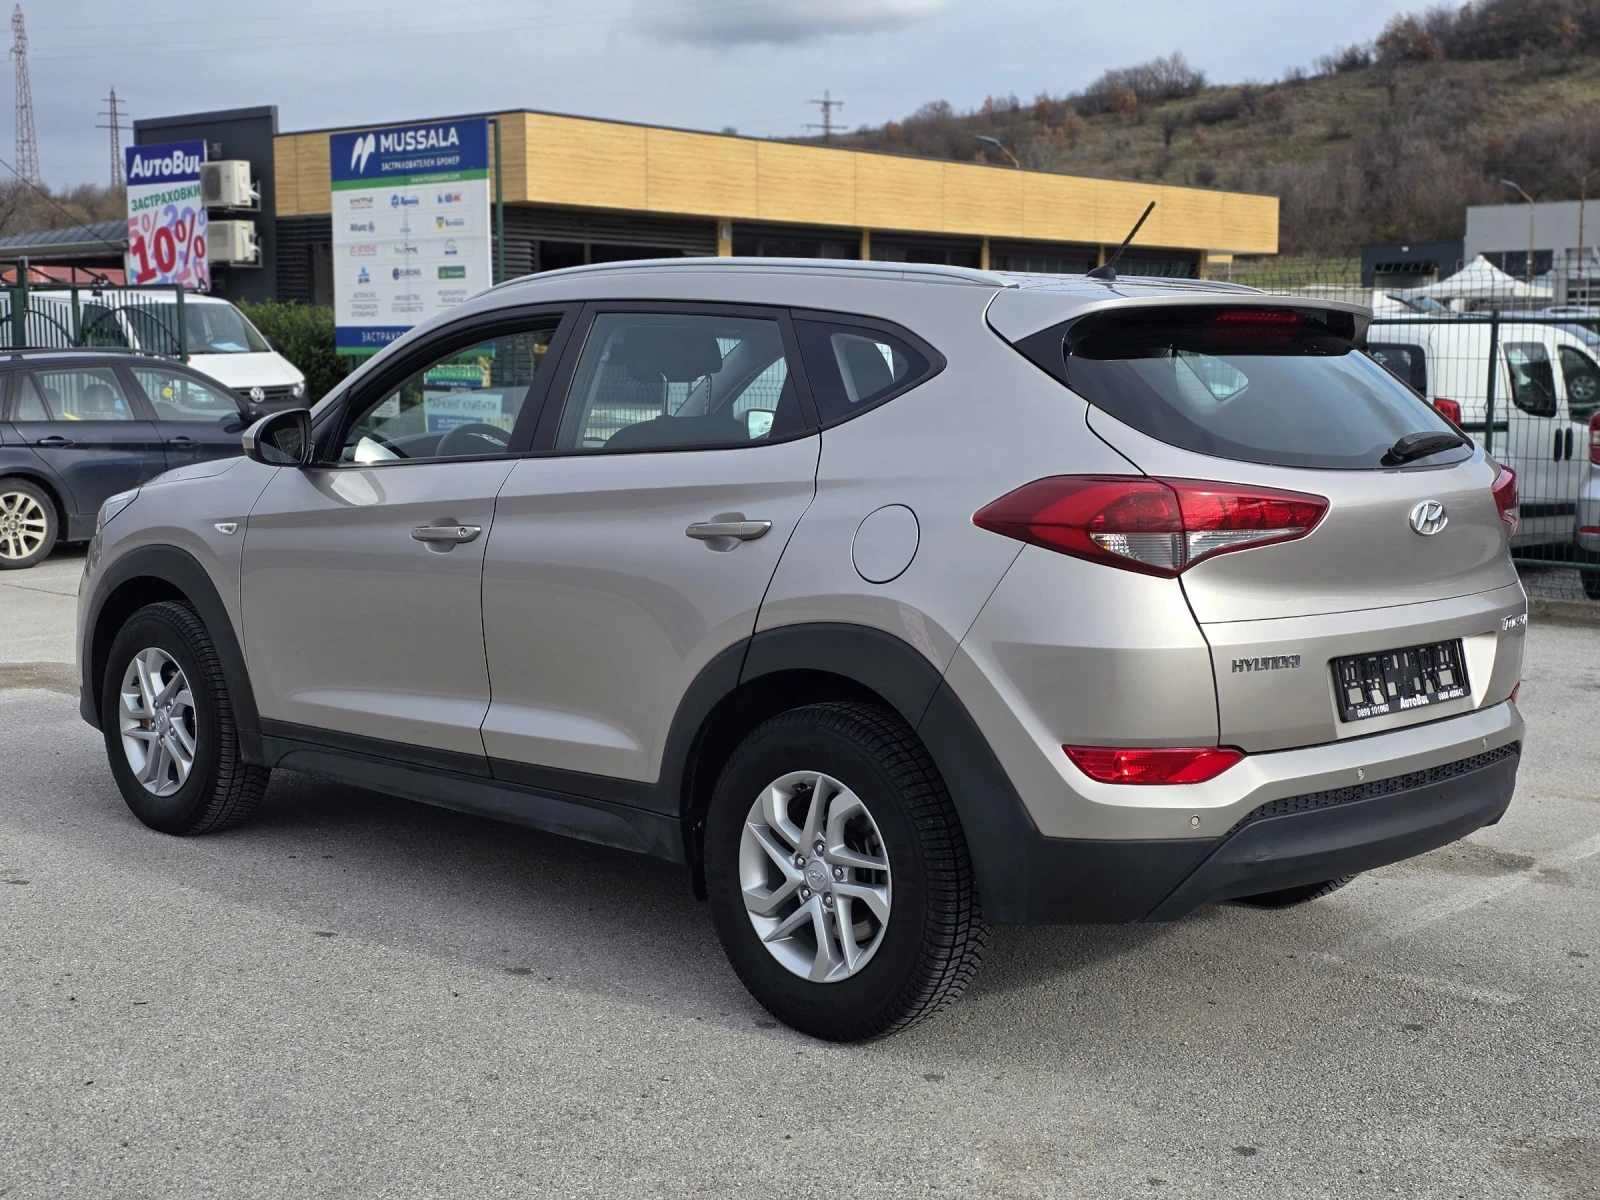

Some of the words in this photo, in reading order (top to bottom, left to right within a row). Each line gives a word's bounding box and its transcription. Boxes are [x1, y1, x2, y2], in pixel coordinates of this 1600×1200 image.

[380, 127, 459, 153] MUSSALA
[381, 158, 435, 171] ЗАСТРАХОВАТЕЛЕН
[436, 155, 460, 167] БРОКЕР
[131, 184, 201, 211] ЗАСТРАХОВКИ
[131, 212, 206, 284] 10%
[1231, 653, 1301, 673] HYUNDAI
[1400, 694, 1430, 709] AutoBul
